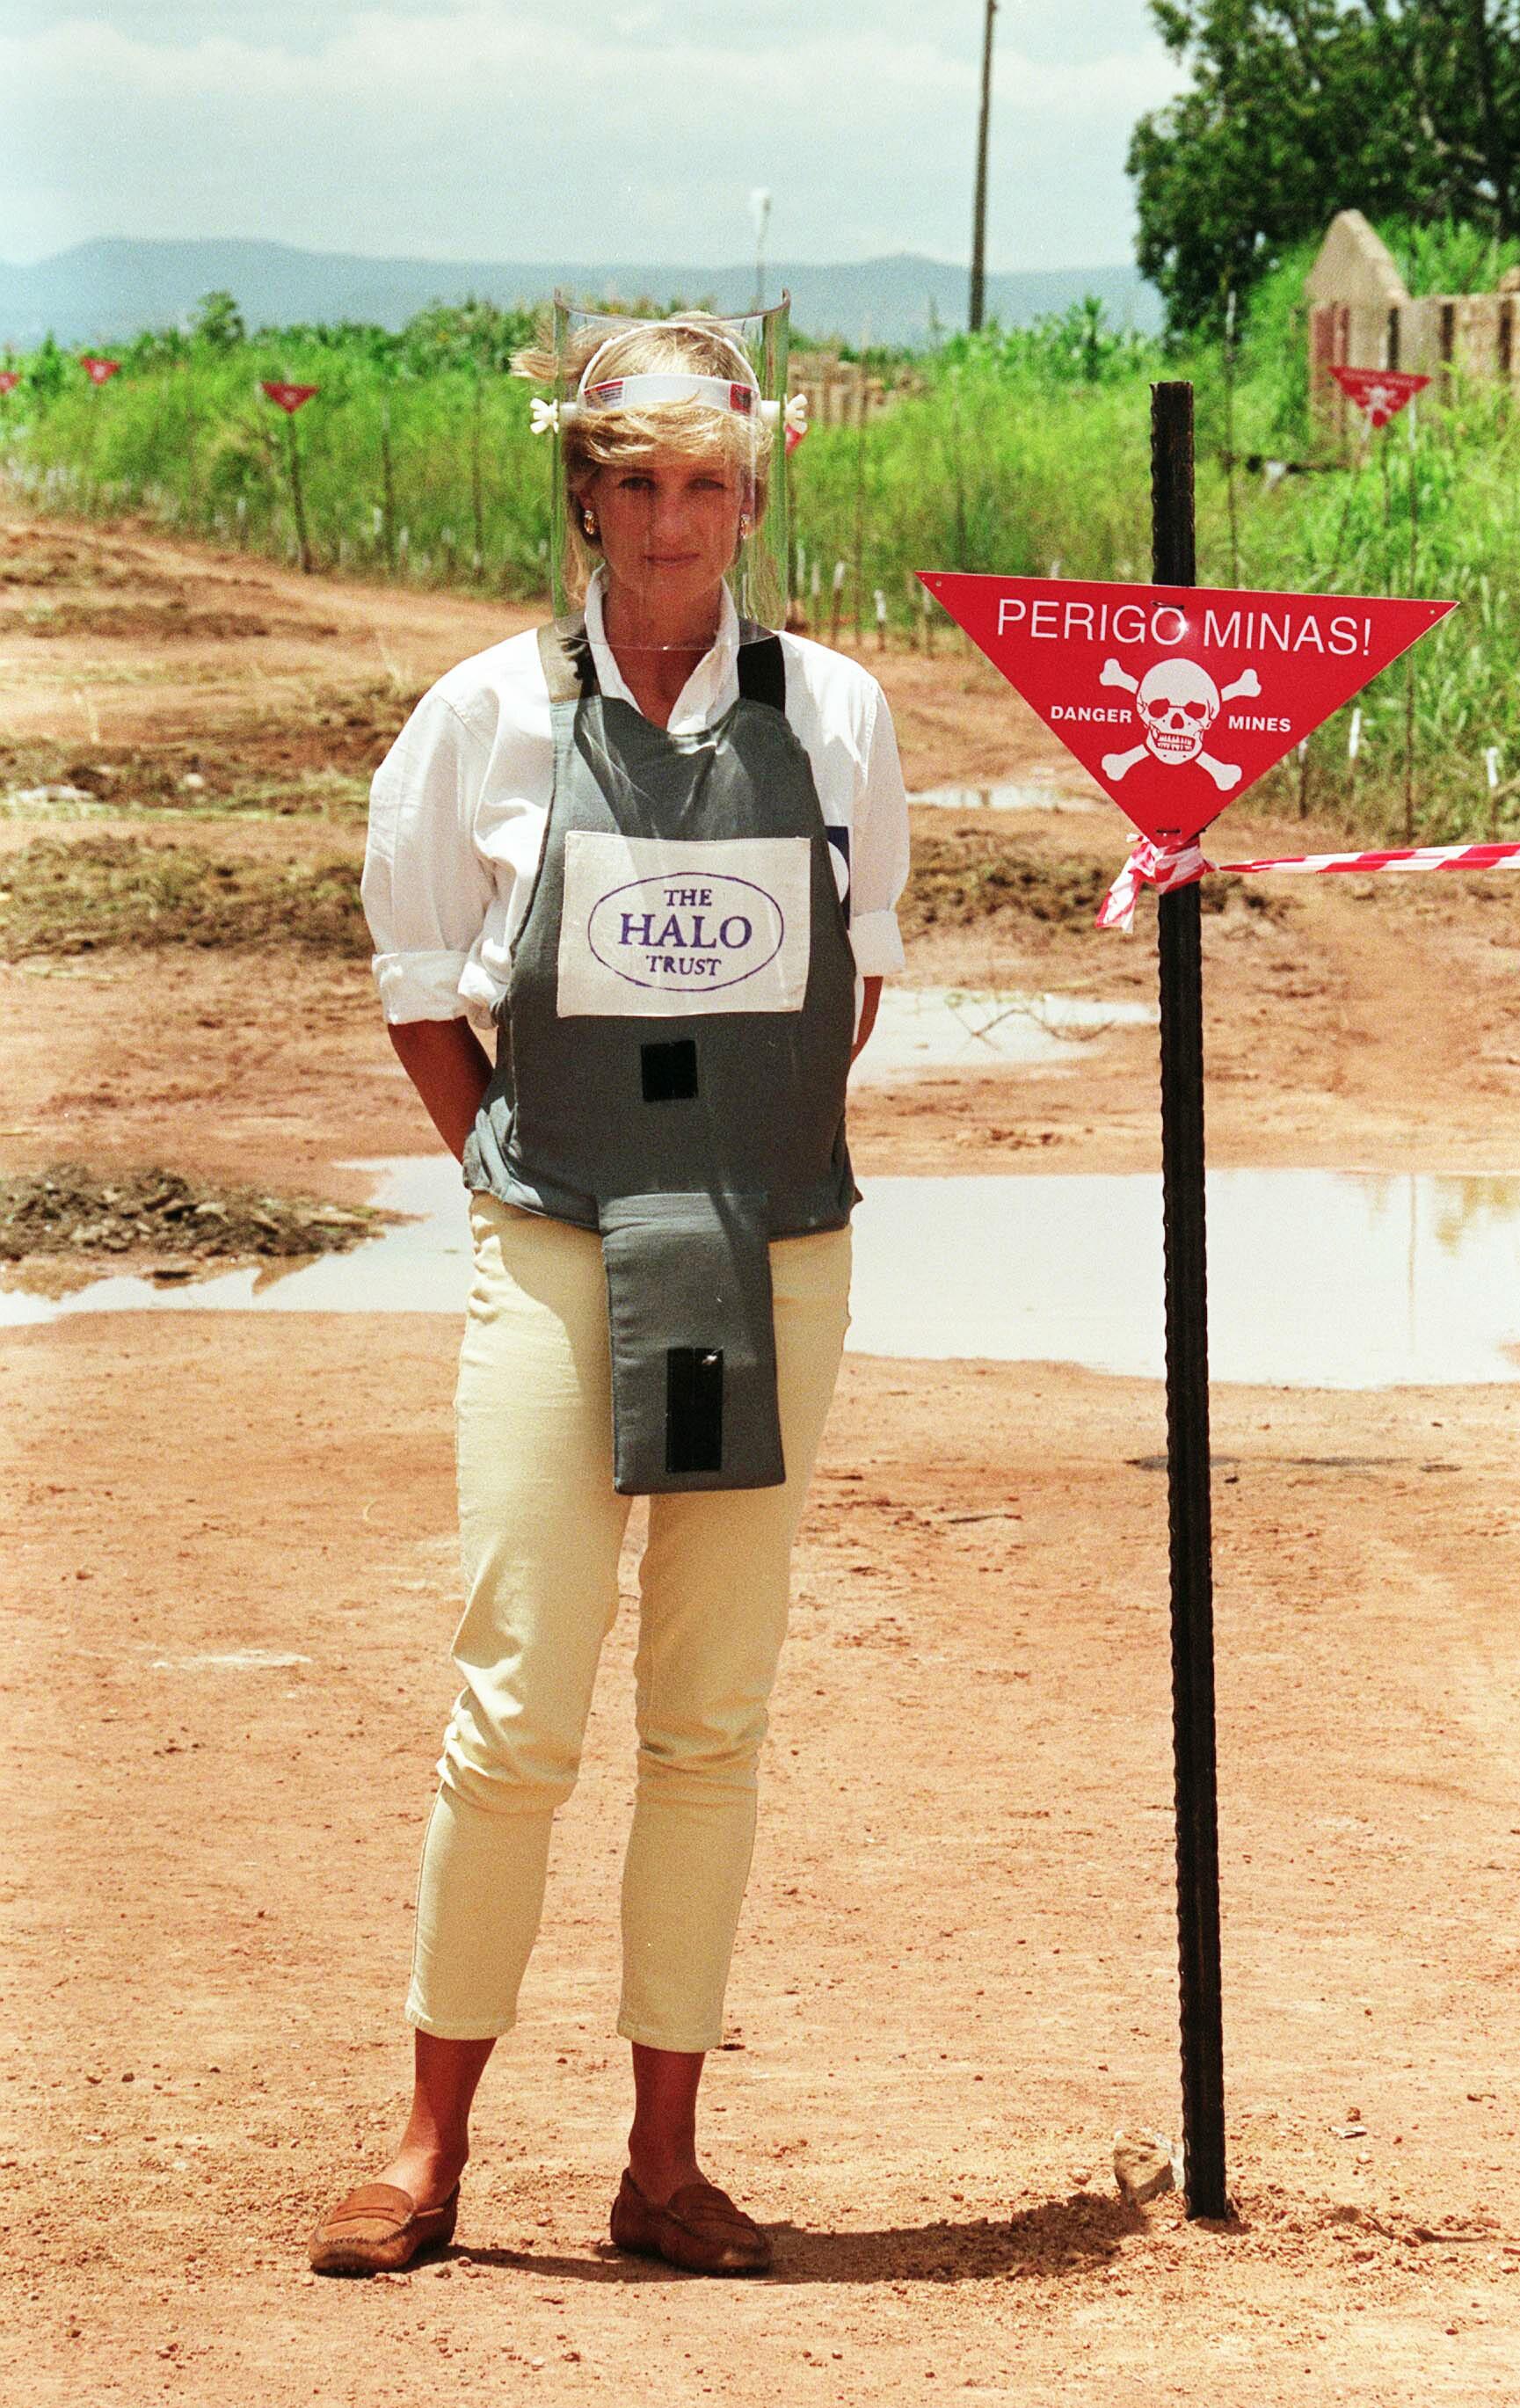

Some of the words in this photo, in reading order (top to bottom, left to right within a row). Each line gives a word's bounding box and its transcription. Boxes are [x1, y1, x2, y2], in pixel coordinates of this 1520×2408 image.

[997, 599, 1187, 646] PERIGO
[1204, 609, 1371, 656] MINAS!
[1051, 705, 1132, 724] DANGER
[1228, 716, 1291, 732] MINES
[664, 889, 712, 906] THE
[618, 913, 753, 949] HALO
[646, 955, 722, 976] TRUST
